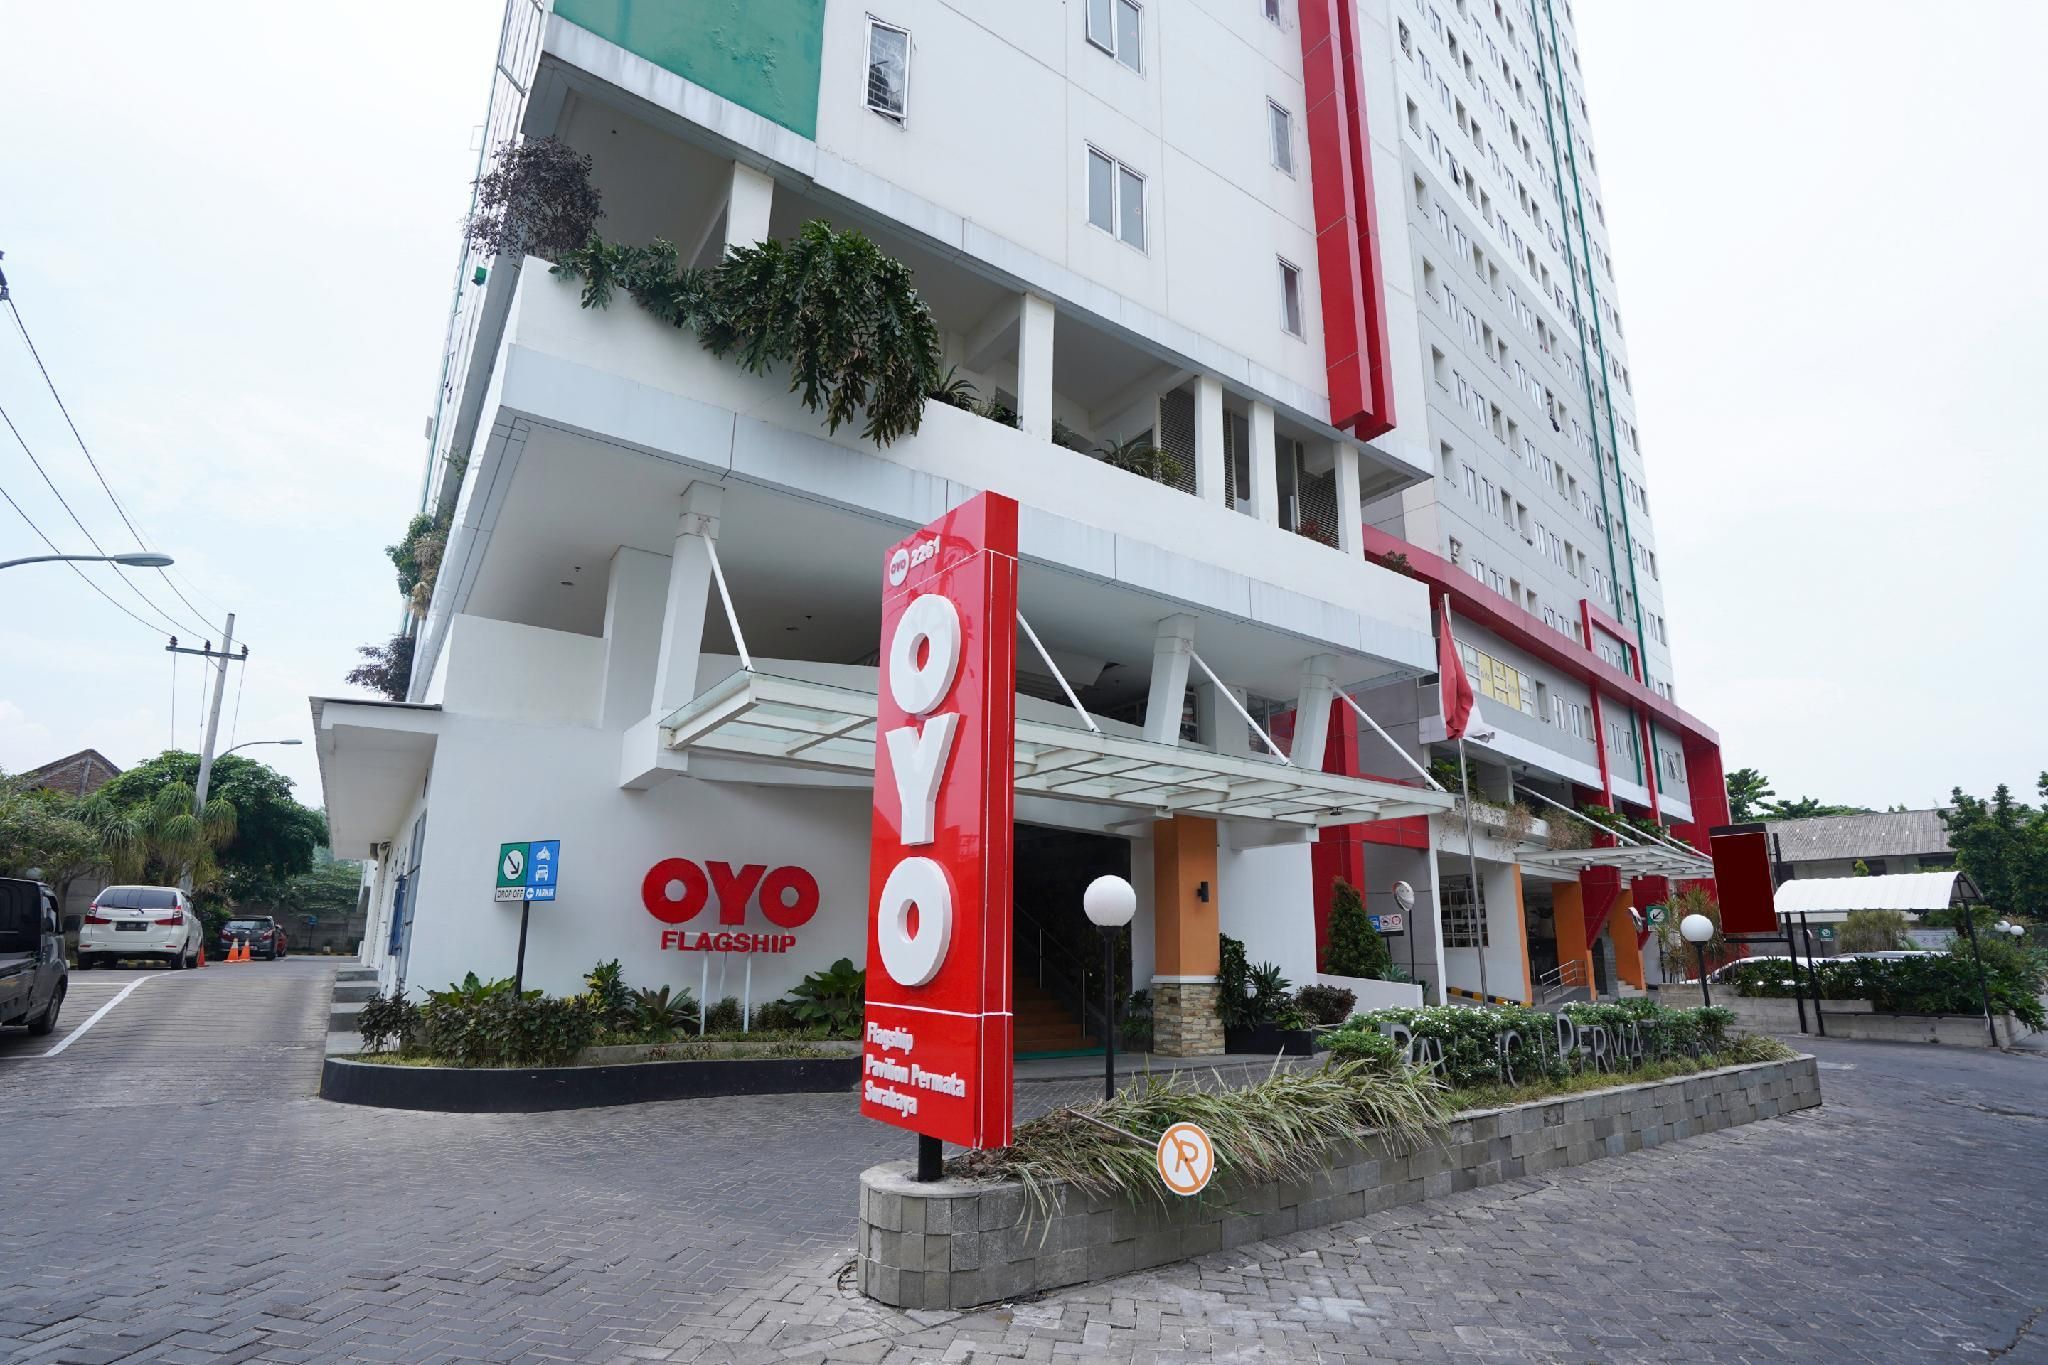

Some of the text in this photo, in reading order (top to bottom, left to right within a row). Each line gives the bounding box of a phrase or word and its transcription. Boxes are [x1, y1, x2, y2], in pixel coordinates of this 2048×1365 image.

[878, 593, 961, 986] OYO
[497, 889, 524, 898] DROP OFF
[641, 857, 820, 928] OYO
[661, 930, 796, 953] FLAGSHIP
[866, 1021, 914, 1055] Flagship
[865, 1054, 966, 1097] Pavilion Permata
[864, 1080, 918, 1118] Surabaya
